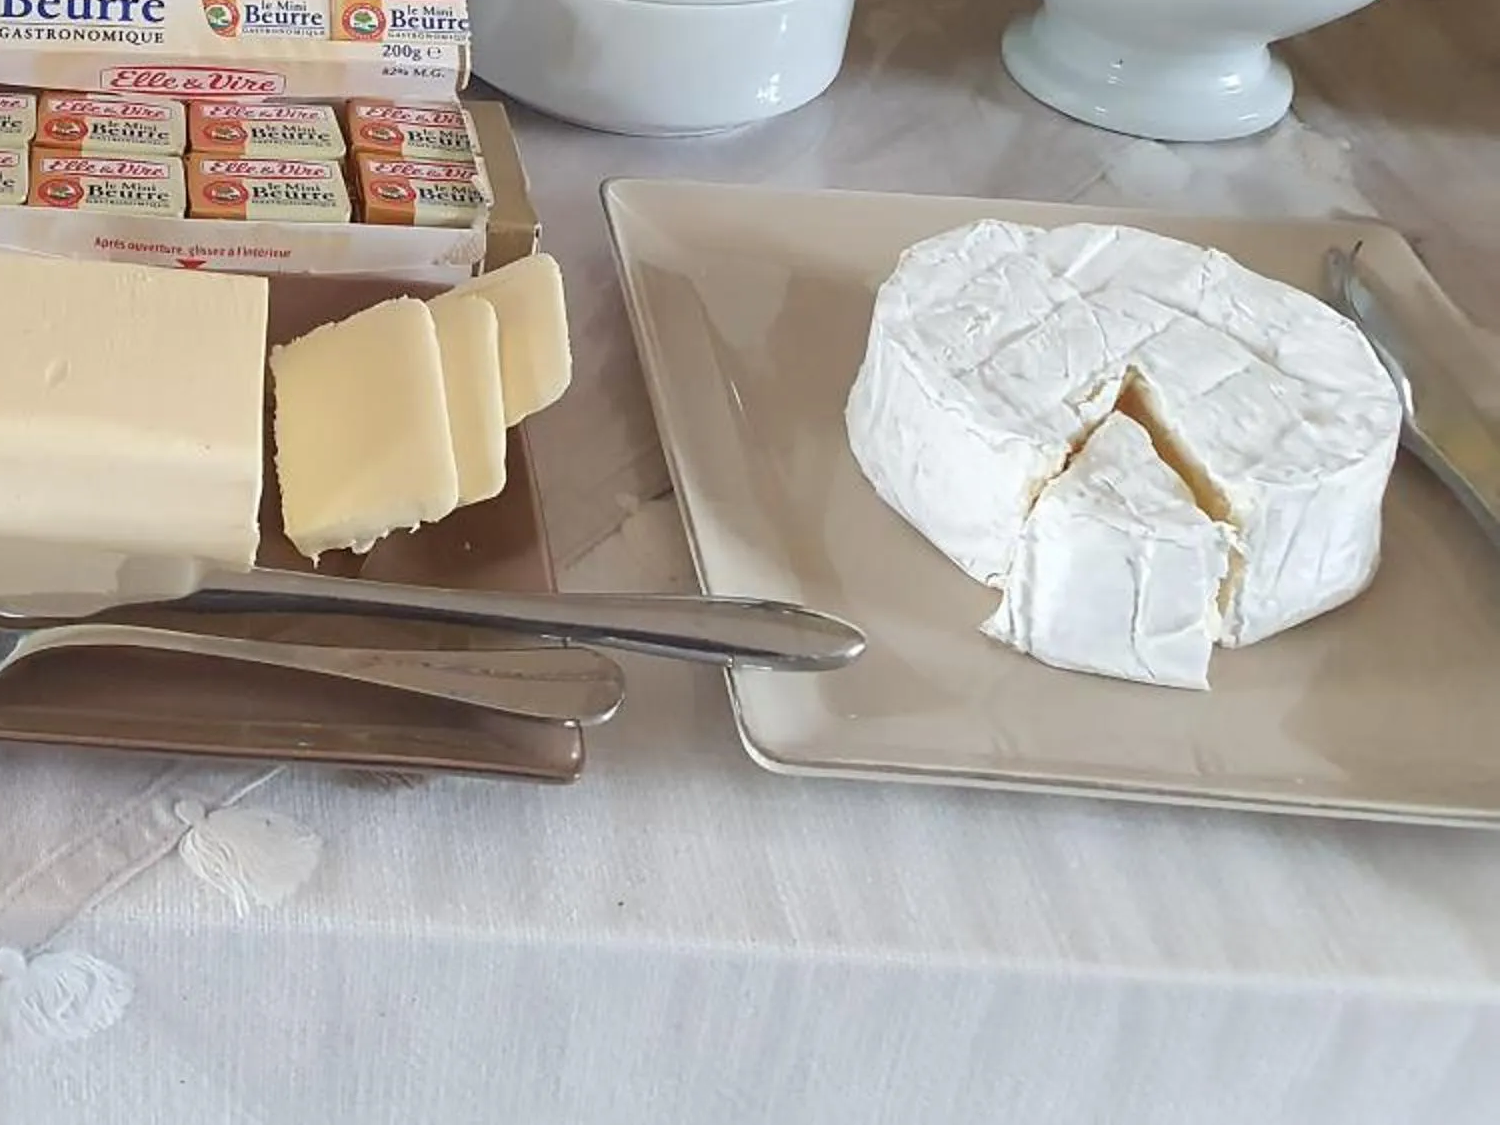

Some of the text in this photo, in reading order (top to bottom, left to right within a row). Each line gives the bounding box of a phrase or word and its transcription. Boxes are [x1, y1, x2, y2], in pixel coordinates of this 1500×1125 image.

[244, 4, 323, 26] Beurre
[261, 0, 308, 13] le Mini
[407, 4, 454, 18] le Mini
[382, 43, 422, 62] 200g
[109, 70, 277, 93] Elle & Vire
